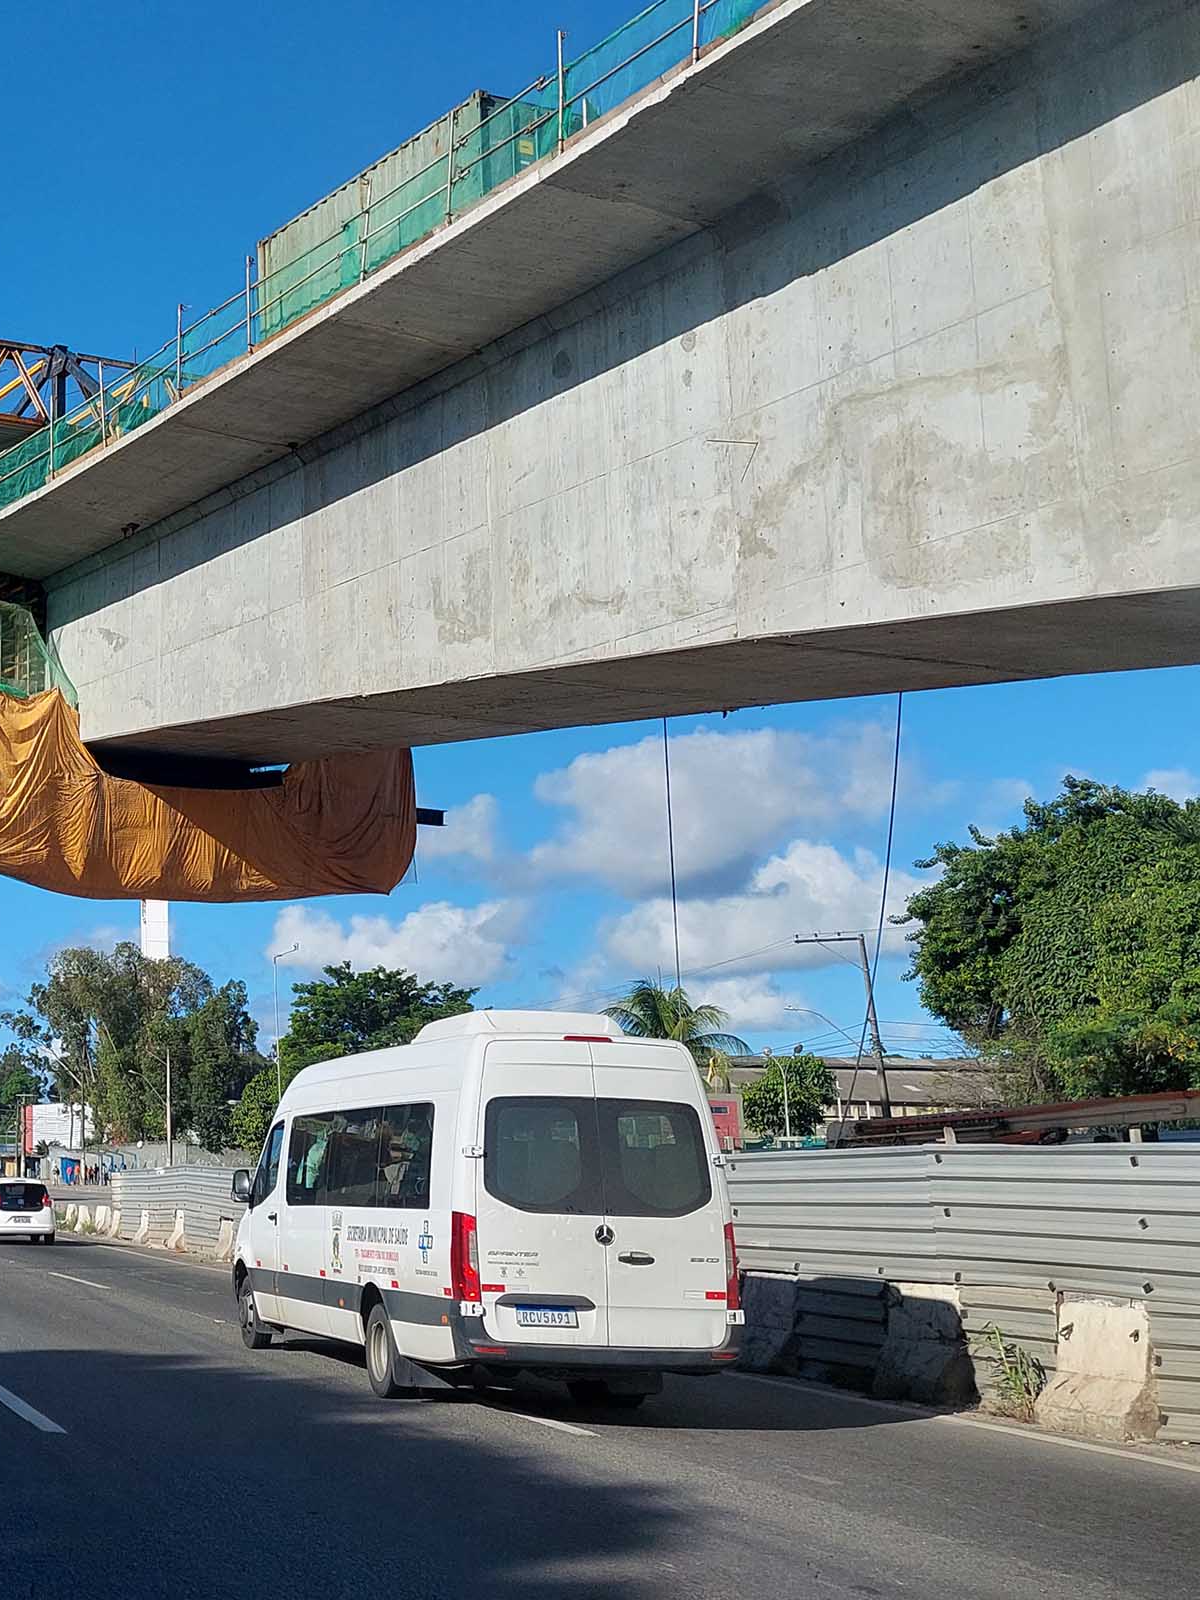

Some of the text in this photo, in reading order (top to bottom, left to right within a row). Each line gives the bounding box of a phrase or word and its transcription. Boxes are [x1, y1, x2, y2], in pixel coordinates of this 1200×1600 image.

[347, 1225, 367, 1241] SECRETARIA
[367, 1226, 388, 1244] MUNICIPAL
[388, 1227, 394, 1244] DE
[522, 1311, 570, 1324] RCV5A91
